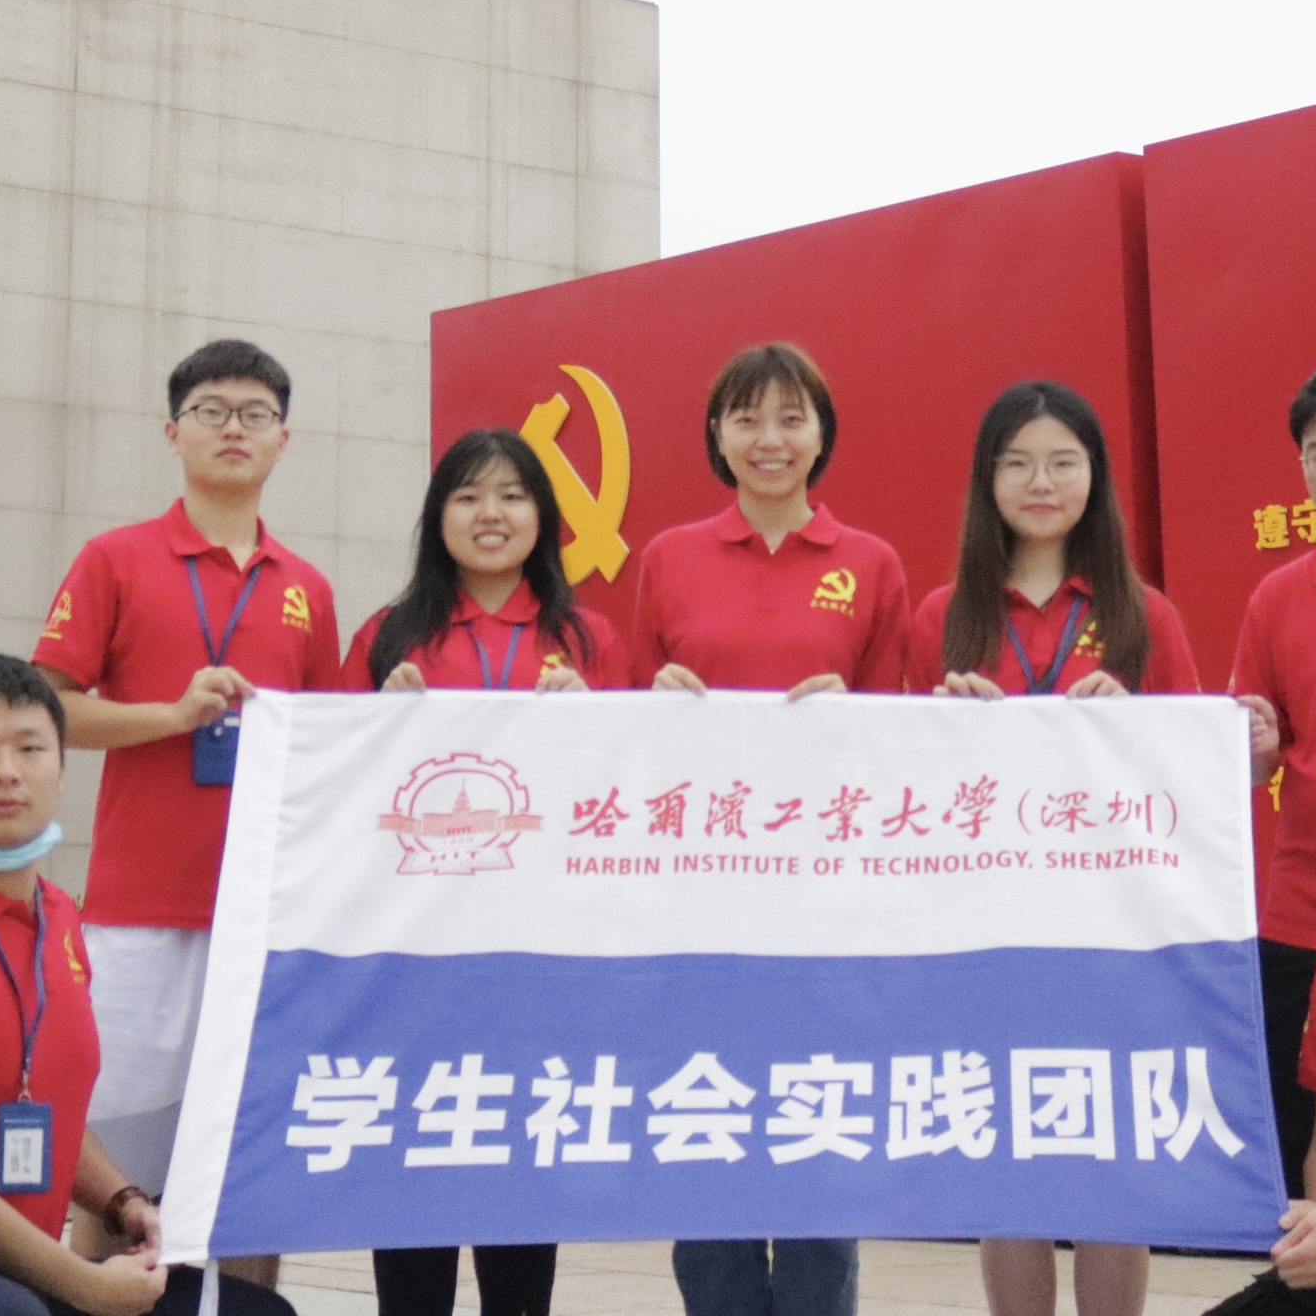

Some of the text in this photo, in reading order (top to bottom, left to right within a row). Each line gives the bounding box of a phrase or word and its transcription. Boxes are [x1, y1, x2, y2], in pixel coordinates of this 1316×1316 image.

[566, 857, 661, 876] HARBIN
[674, 855, 800, 875] INSTITUTE
[813, 857, 845, 875] OF
[1045, 848, 1180, 870] SHENZHEN
[286, 1047, 1246, 1174] 学生社会实践团队
